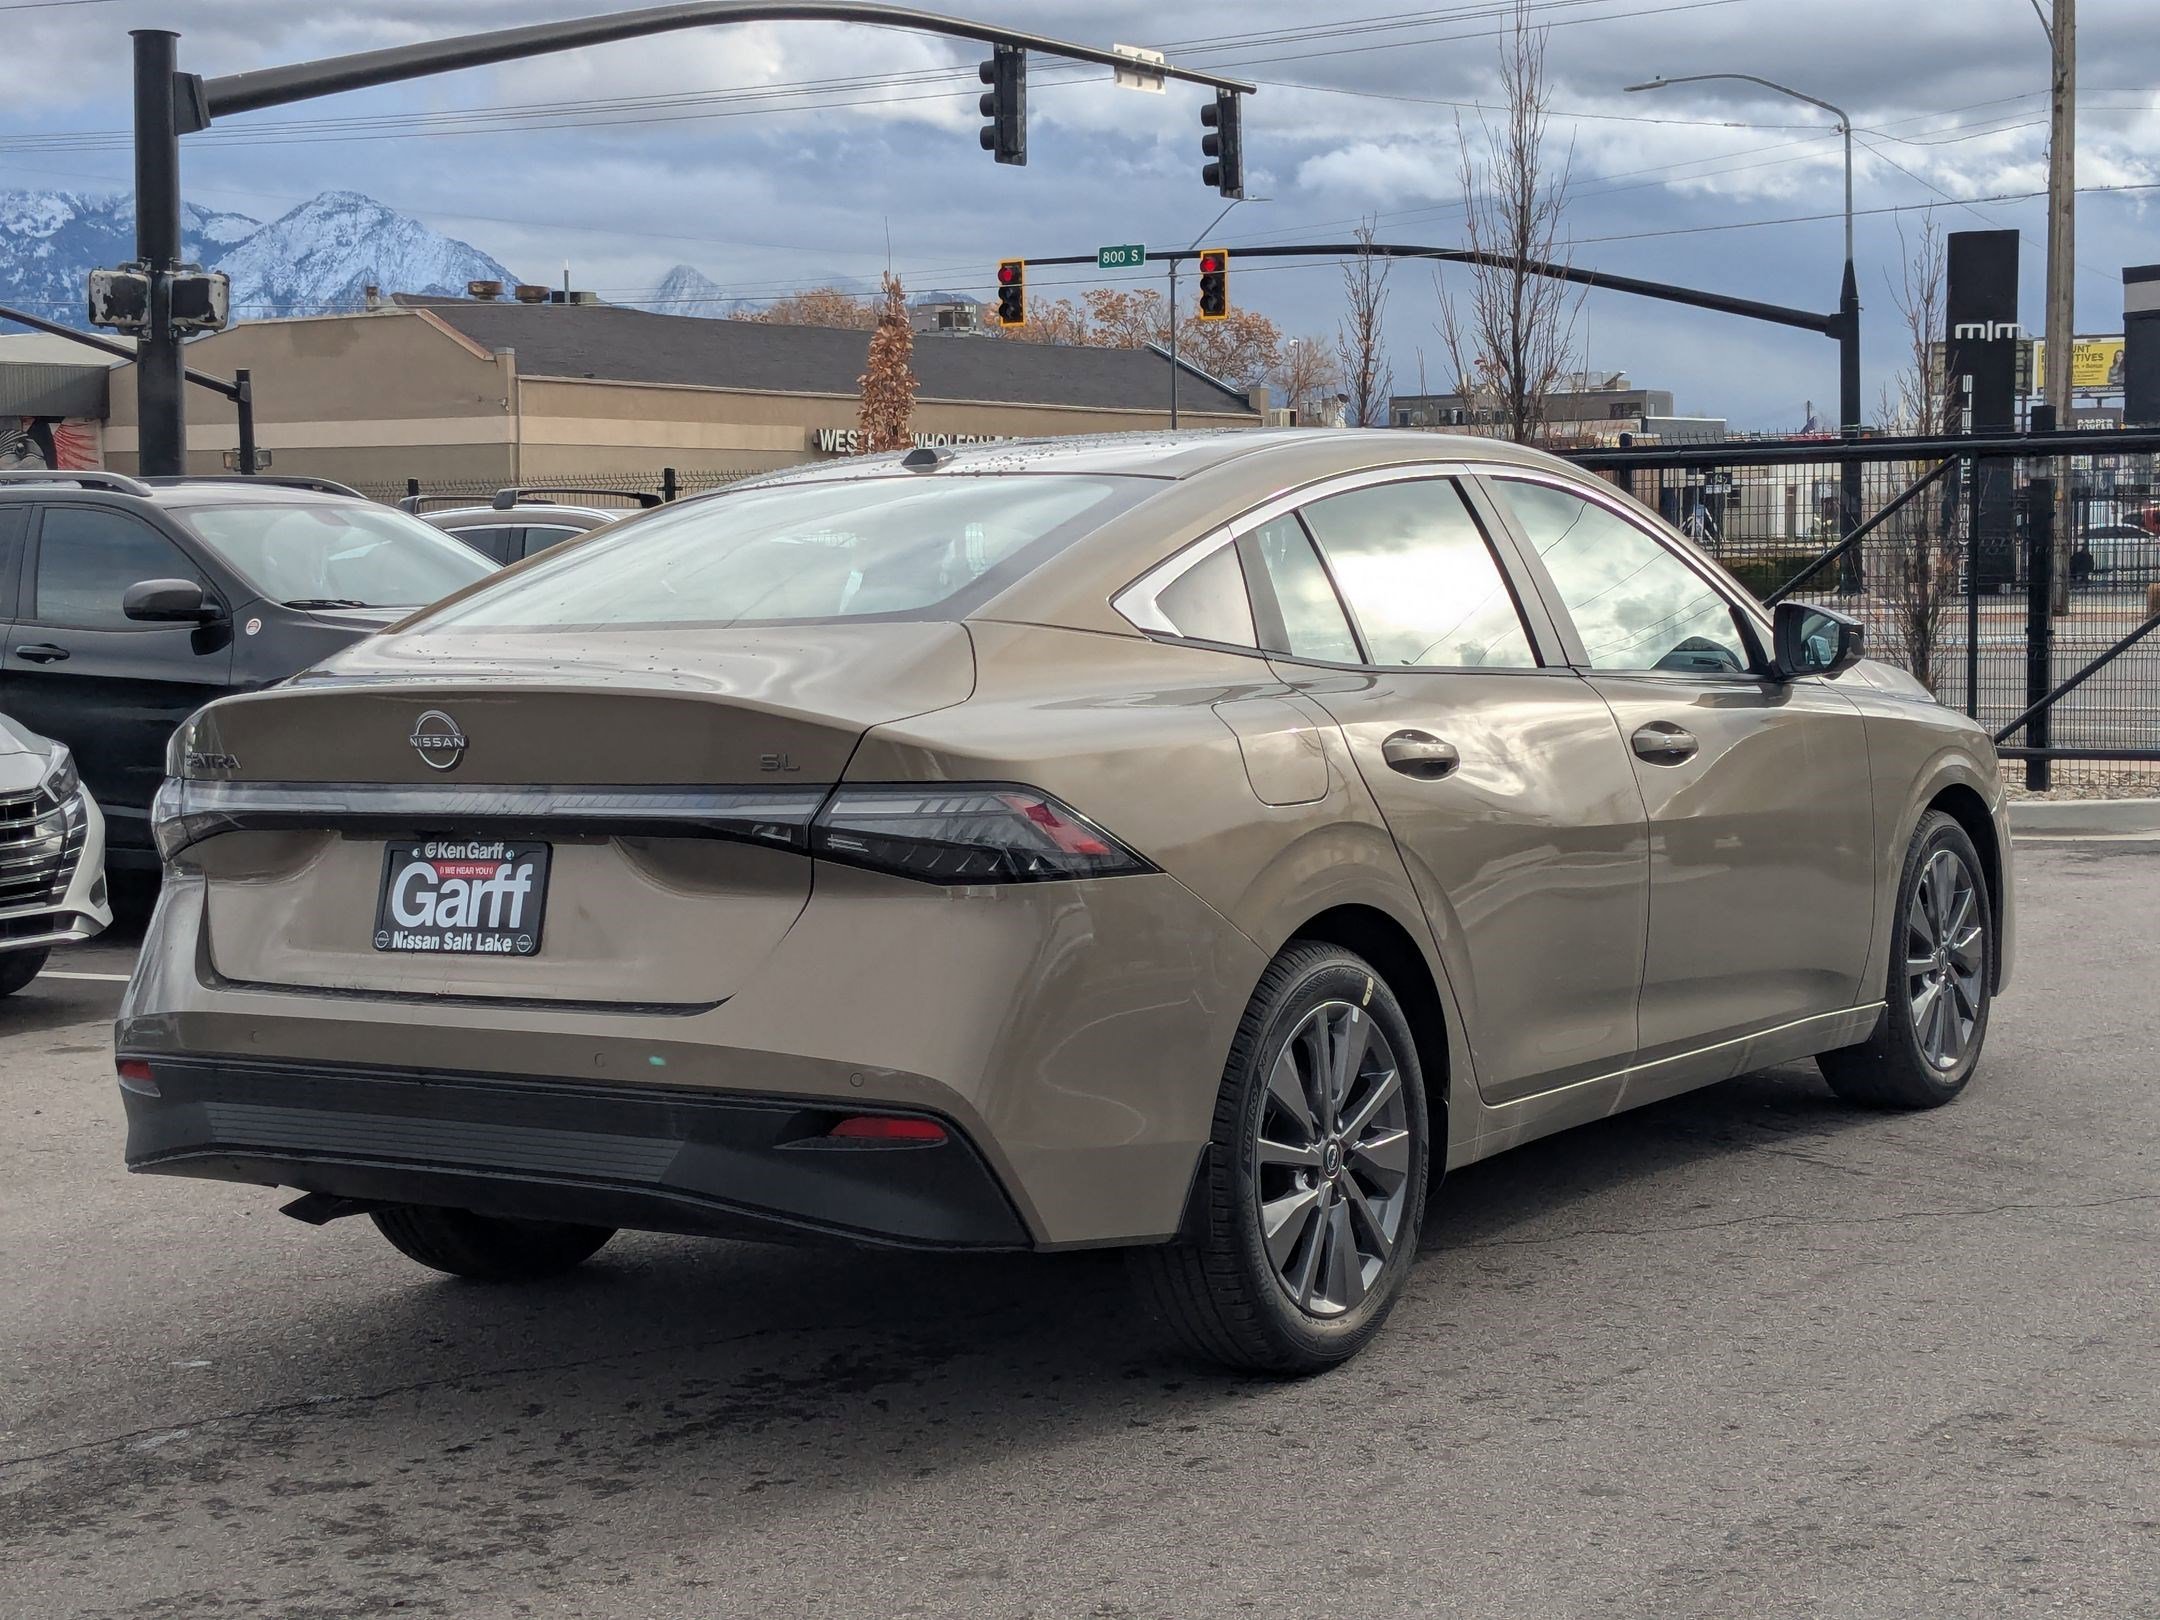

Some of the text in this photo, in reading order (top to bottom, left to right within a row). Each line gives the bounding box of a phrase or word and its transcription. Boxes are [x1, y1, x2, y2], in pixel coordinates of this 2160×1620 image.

[1102, 251, 1126, 264] 800
[410, 736, 465, 748] NISSAN
[760, 753, 800, 772] SL
[437, 842, 504, 860] Ken Garff
[475, 866, 489, 875] YOU
[392, 861, 533, 928] Garff
[392, 931, 512, 952] Nissan Salt Lake
